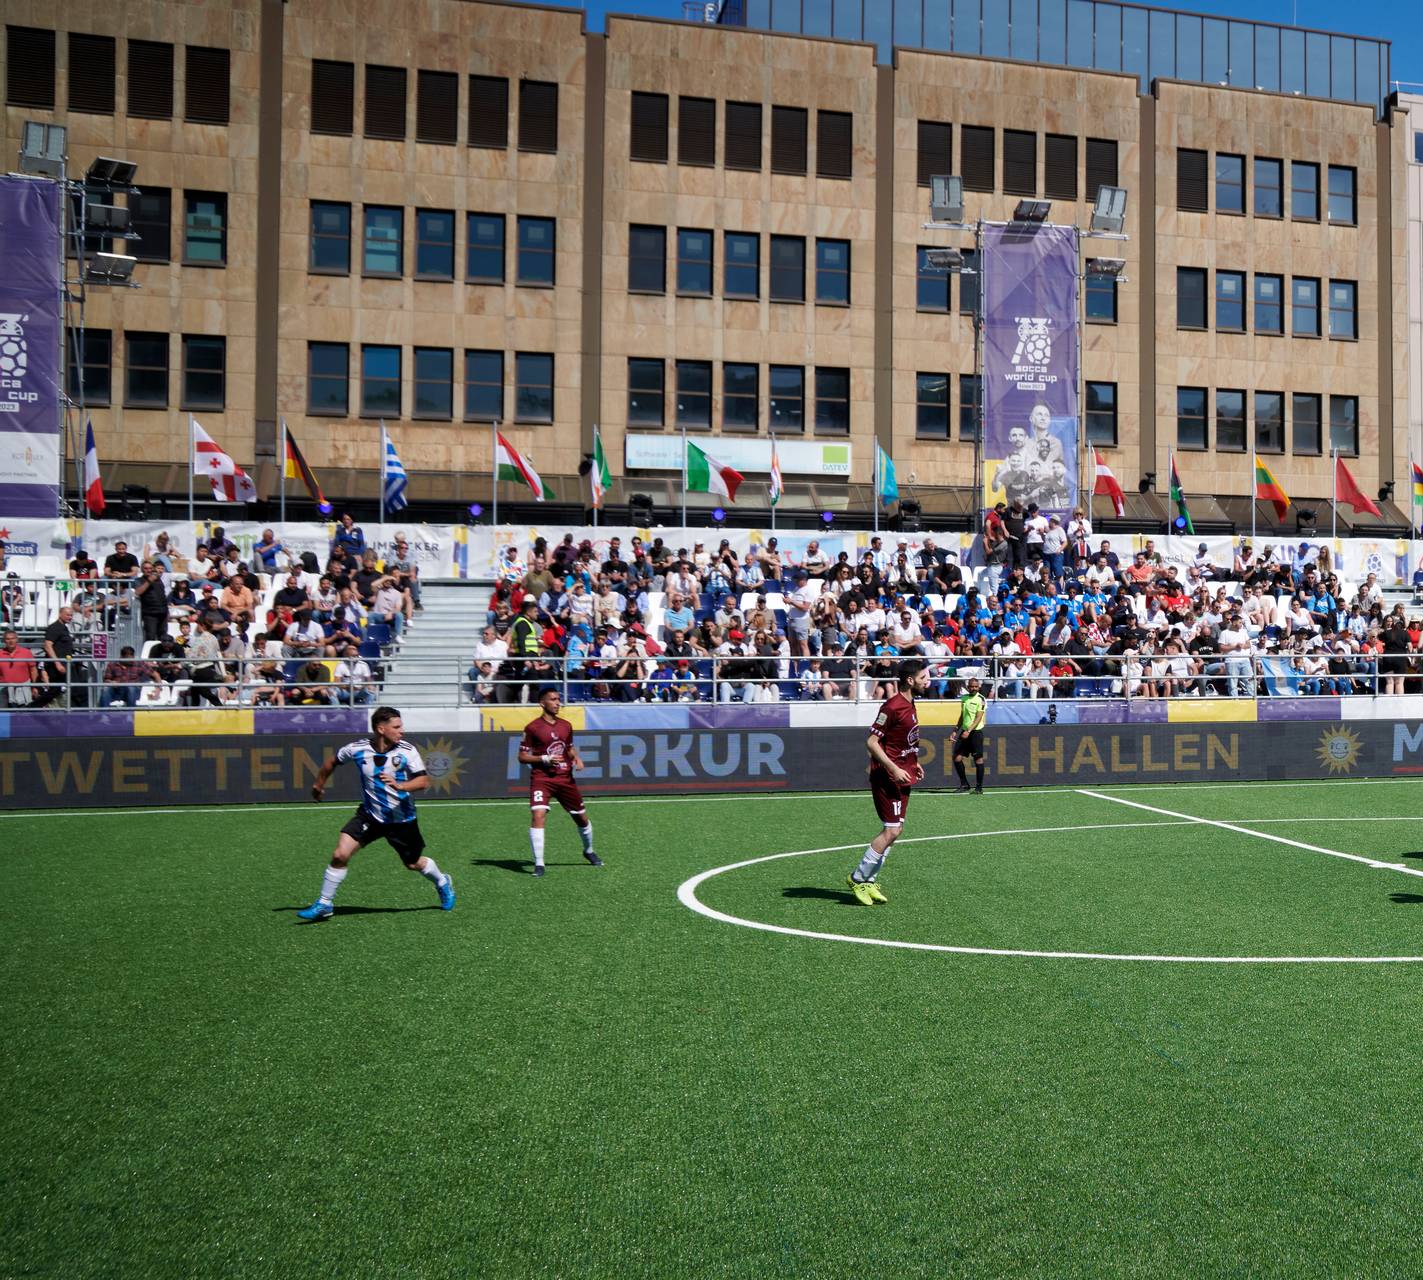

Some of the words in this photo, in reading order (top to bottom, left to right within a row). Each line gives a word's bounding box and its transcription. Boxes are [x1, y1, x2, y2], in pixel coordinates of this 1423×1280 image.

[1004, 373, 1034, 381] world
[1038, 375, 1058, 384] cup
[8, 391, 38, 403] cup
[3, 543, 34, 554] eken
[900, 732, 1239, 777] PIELHALLEN
[533, 790, 543, 802] 2
